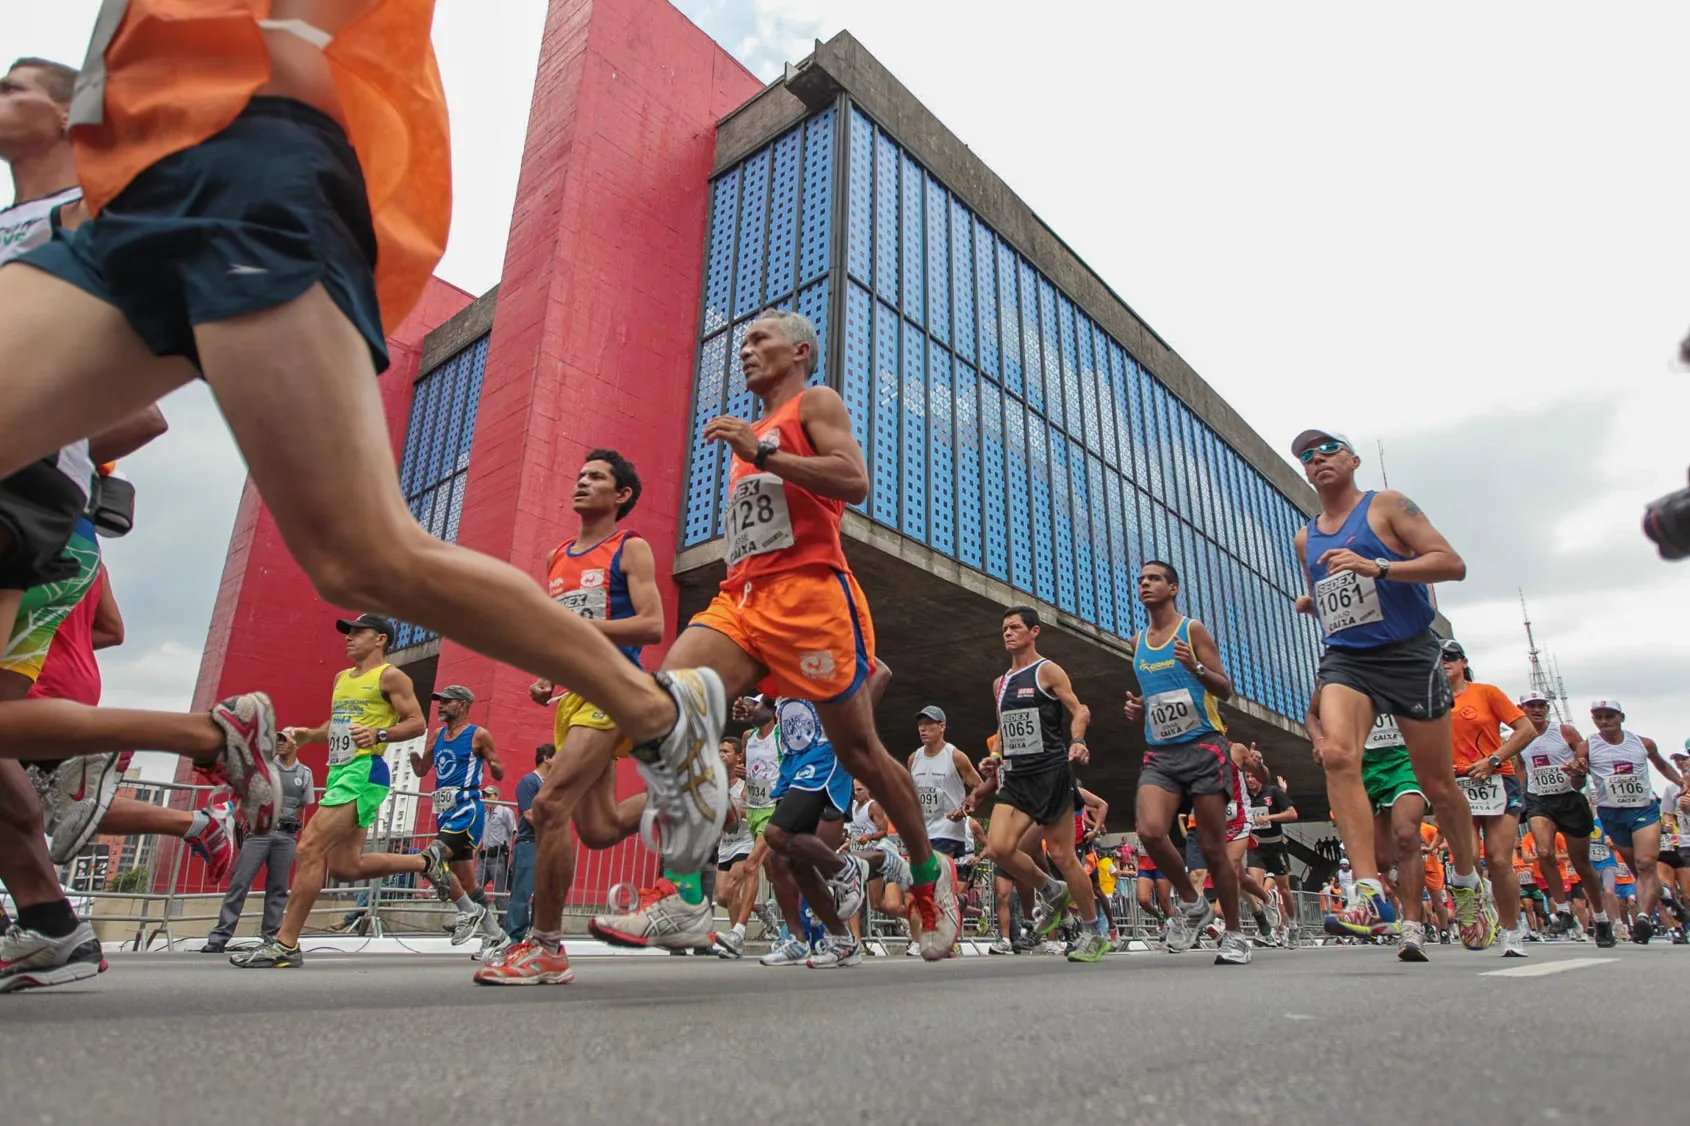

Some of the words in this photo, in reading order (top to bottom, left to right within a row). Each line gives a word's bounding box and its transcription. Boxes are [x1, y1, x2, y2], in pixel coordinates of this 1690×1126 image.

[1318, 573, 1357, 598] SEDEX
[1320, 584, 1364, 617] 1061
[1329, 616, 1356, 632] CAIXA
[1003, 712, 1029, 724] SEDEX
[1151, 702, 1188, 725] 1020
[1003, 721, 1034, 738] 1065
[1160, 726, 1183, 738] CAIXA
[329, 735, 350, 752] 019
[1373, 734, 1398, 742] CAIXA
[1535, 773, 1565, 786] 1086
[1467, 785, 1498, 801] 067
[1609, 783, 1644, 795] 1106
[920, 794, 938, 805] 091
